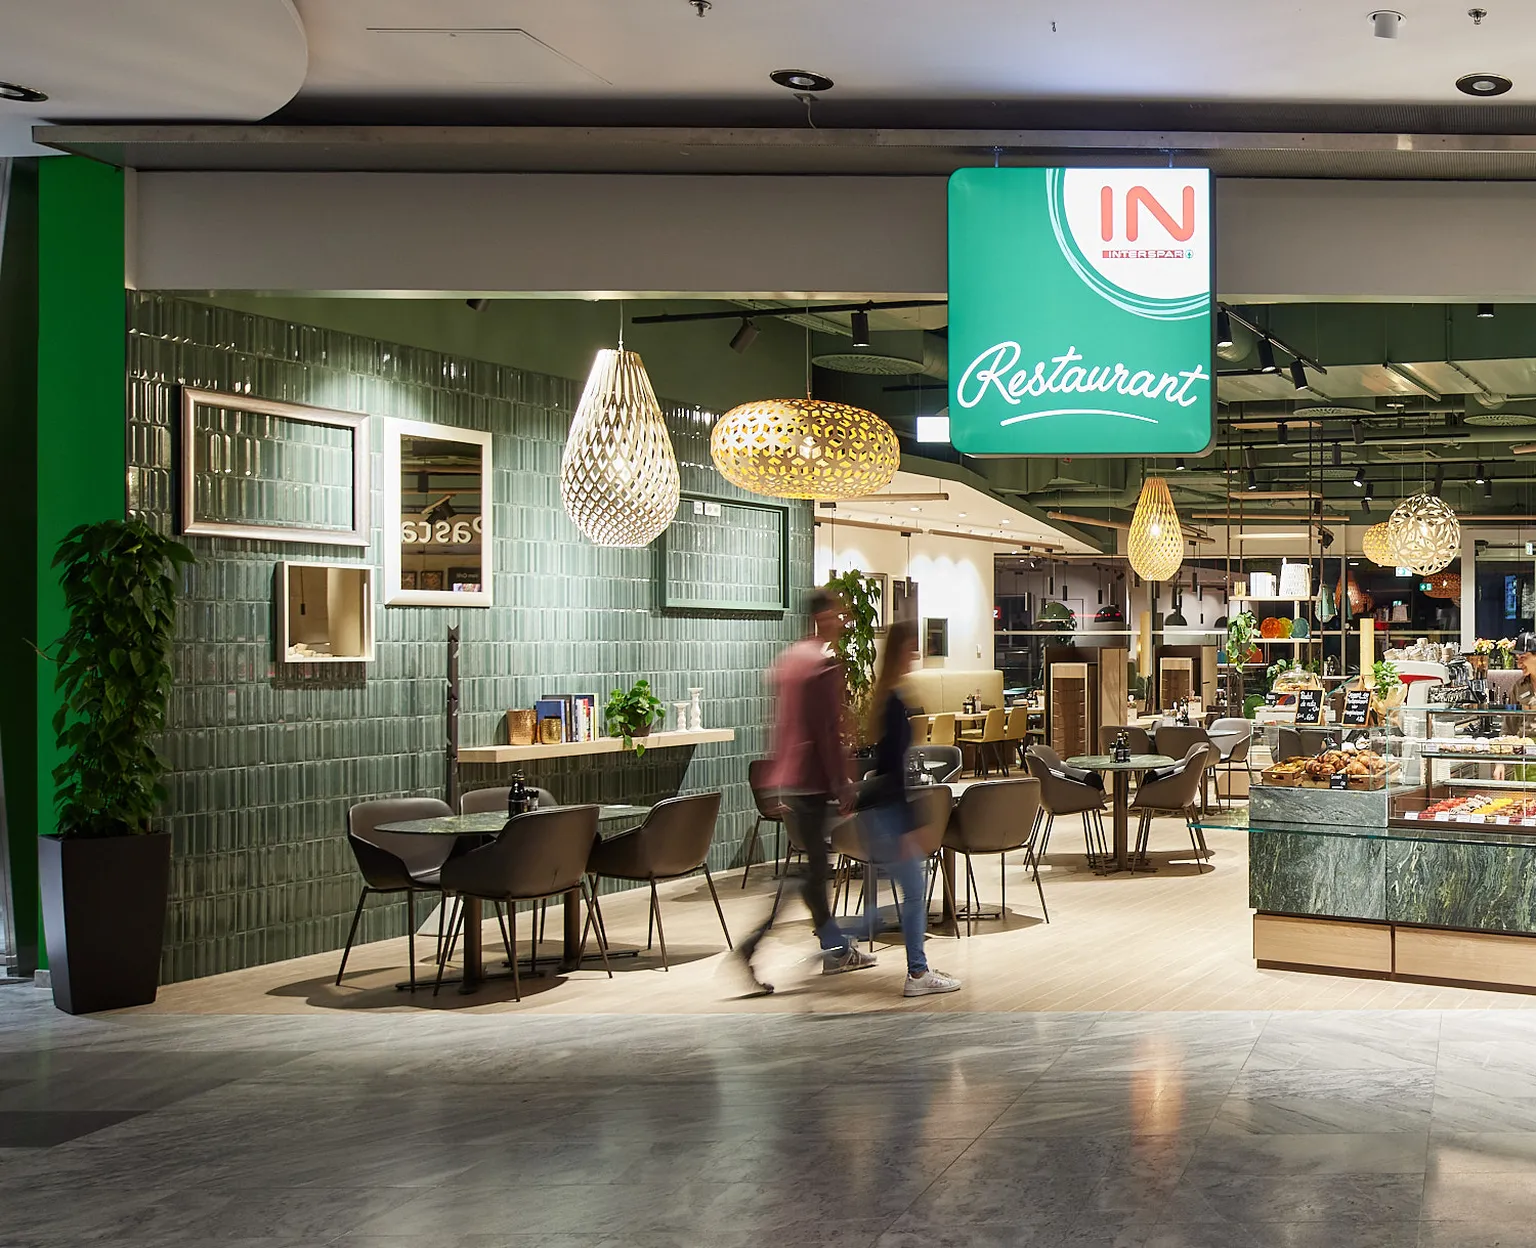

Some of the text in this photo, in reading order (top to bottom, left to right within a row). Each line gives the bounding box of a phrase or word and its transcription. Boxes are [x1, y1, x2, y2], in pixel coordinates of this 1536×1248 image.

[1101, 186, 1195, 242] IN
[1107, 250, 1184, 258] INTERSPAR
[957, 341, 1210, 408] Restaurant
